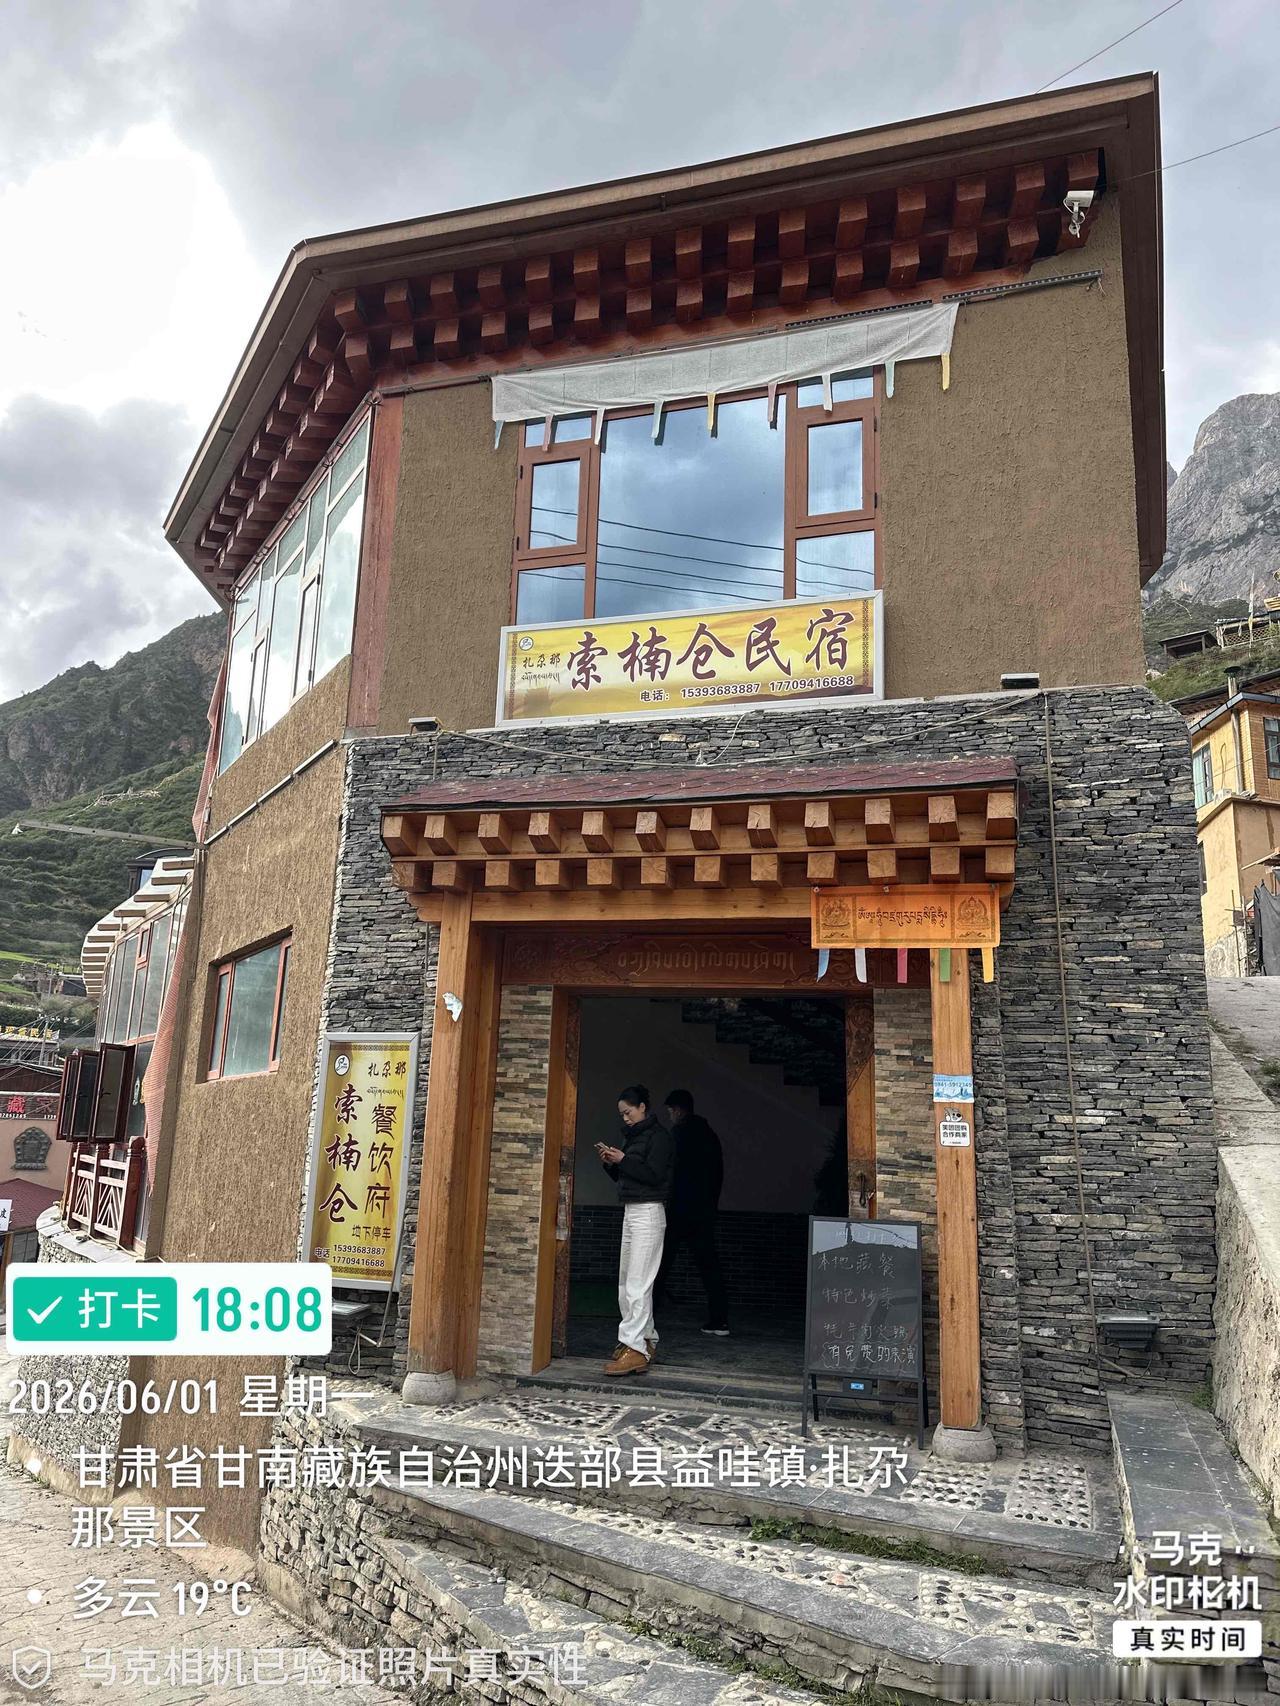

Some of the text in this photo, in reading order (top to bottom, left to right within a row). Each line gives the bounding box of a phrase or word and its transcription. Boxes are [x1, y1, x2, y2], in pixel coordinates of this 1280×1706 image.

[567, 608, 855, 691] 索楠仓民宿
[522, 652, 561, 669] 扎尕那
[680, 683, 761, 699] 15393683887
[768, 674, 855, 693] 17709416688
[367, 1060, 407, 1080] 扎尕那
[319, 1083, 363, 1223] 索楠仓
[364, 1103, 398, 1221] 餐饮府
[351, 1224, 391, 1242] 地下停车
[314, 1247, 330, 1259] 电话
[334, 1244, 386, 1256] 15393683887
[332, 1256, 385, 1268] 17709416688
